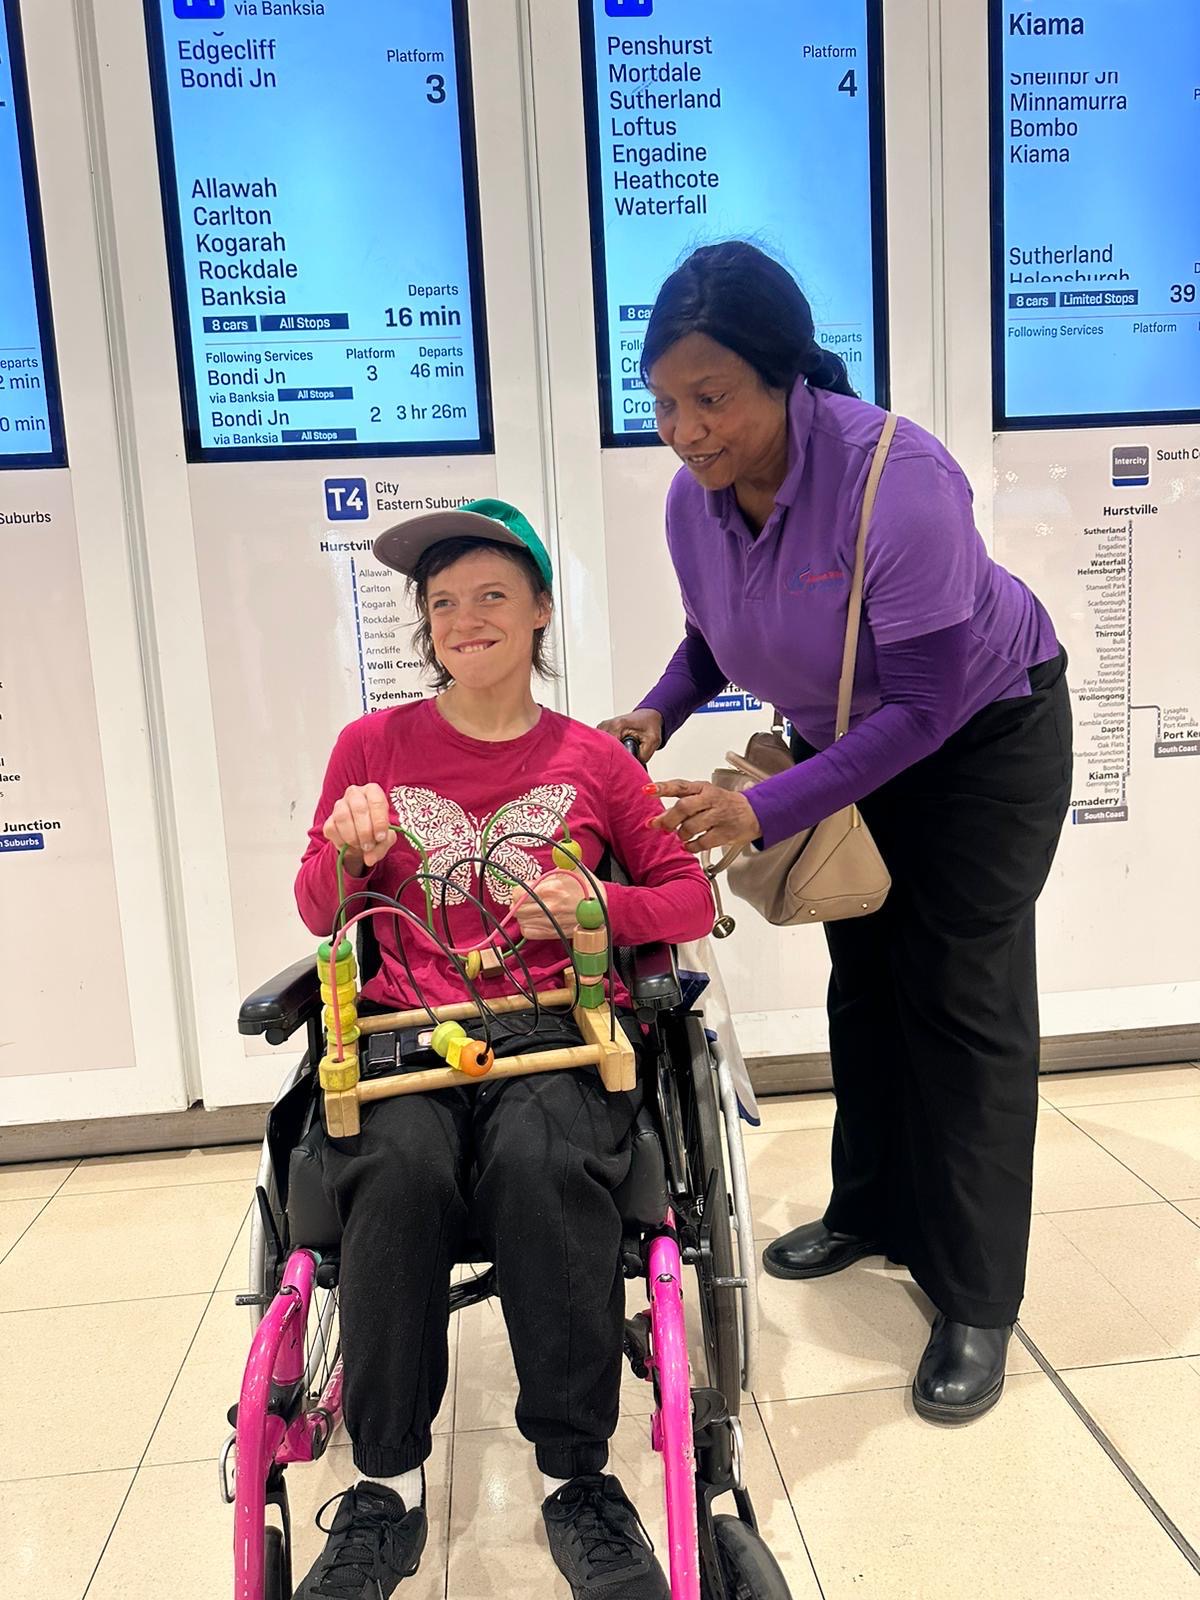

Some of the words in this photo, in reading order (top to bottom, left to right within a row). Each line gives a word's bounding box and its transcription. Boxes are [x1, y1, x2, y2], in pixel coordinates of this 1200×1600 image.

[234, 0, 258, 16] via
[262, 0, 325, 16] Banksia
[1009, 12, 1084, 36] Kiama
[178, 39, 276, 64] Edgecliff
[608, 35, 713, 55] Penshurst
[803, 46, 857, 58] Platform
[387, 49, 444, 63] Platform
[181, 68, 243, 88] Bondi
[250, 69, 277, 87] Jn
[609, 62, 702, 83] Mortdale
[426, 74, 446, 104] 3
[838, 70, 858, 97] 4
[610, 89, 722, 110] Sutherland
[1010, 92, 1127, 111] Minnamurra
[612, 116, 677, 137] Loftus
[1010, 118, 1078, 137] Bombo
[613, 143, 707, 167] Engadine
[1010, 145, 1070, 163] Kiama
[614, 170, 719, 190] Heathcote
[192, 177, 277, 199] Allawah
[615, 195, 707, 216] Waterfall
[193, 206, 272, 226] Carlton
[197, 232, 286, 257] Kogarah
[1009, 244, 1113, 266] Sutherland
[200, 259, 298, 280] Rockdale
[202, 286, 286, 306] Banksia
[408, 284, 459, 298] Departs
[1170, 284, 1196, 303] 39
[1016, 296, 1024, 307] 8
[1026, 296, 1049, 307] cars
[1064, 293, 1103, 306] Limited
[1104, 293, 1135, 306] Stops
[385, 307, 413, 328] 16
[420, 305, 461, 327] min
[628, 308, 636, 319] 8
[212, 320, 221, 331] 8
[223, 320, 249, 331] cars
[280, 317, 295, 329] All
[296, 316, 331, 330] Stops
[1133, 322, 1177, 334] Platform
[821, 333, 863, 344] Departs
[1008, 327, 1058, 339] Following
[1060, 325, 1104, 336] Services
[206, 351, 262, 366] Following
[265, 350, 313, 362] Services
[346, 347, 396, 360] Platform
[419, 346, 463, 360] Departs
[0, 357, 39, 371] eparts
[410, 363, 431, 378] 46
[436, 362, 464, 378] min
[208, 368, 259, 386] Bondi
[264, 368, 286, 384] Jn
[367, 365, 378, 382] 3
[10, 374, 40, 389] min
[210, 393, 226, 404] via
[230, 392, 275, 403] Banksia
[298, 390, 308, 399] All
[310, 389, 334, 400] Stops
[212, 409, 263, 427] Bondi
[267, 409, 290, 426] Jn
[370, 407, 381, 423] 2
[397, 406, 407, 421] 3
[411, 405, 428, 420] hr
[432, 404, 467, 420] 26m
[15, 416, 46, 431] min
[214, 434, 230, 445] via
[233, 432, 279, 444] Banksia
[302, 431, 312, 441] All
[313, 431, 338, 441] Stops
[1115, 457, 1148, 466] Intercity
[1157, 449, 1190, 461] South
[375, 482, 400, 496] City
[328, 487, 364, 512] T4
[377, 499, 424, 511] Eastern
[1103, 504, 1159, 517] Hurstville
[1084, 527, 1126, 535] Sutherland
[1091, 559, 1126, 567] Waterfall
[360, 570, 393, 578] Allawah
[1077, 567, 1126, 576] Helensburgh
[360, 585, 391, 593] Carlton
[362, 600, 397, 610] Kogarah
[363, 616, 400, 624] Rockdale
[365, 631, 396, 640] Banksia
[1096, 630, 1126, 638] Thirroul
[366, 646, 401, 655] Arncliffe
[367, 661, 394, 671] Wolli
[396, 660, 425, 669] Creek
[369, 677, 396, 687] Tempe
[370, 691, 424, 702] Sydenham
[1164, 731, 1184, 739] Port
[1158, 746, 1178, 754] South
[1089, 772, 1120, 780] Kiama
[1070, 797, 1120, 807] omaderry
[1084, 812, 1105, 820] South
[4, 820, 61, 833] Junction
[4, 838, 39, 848] Suburbs
